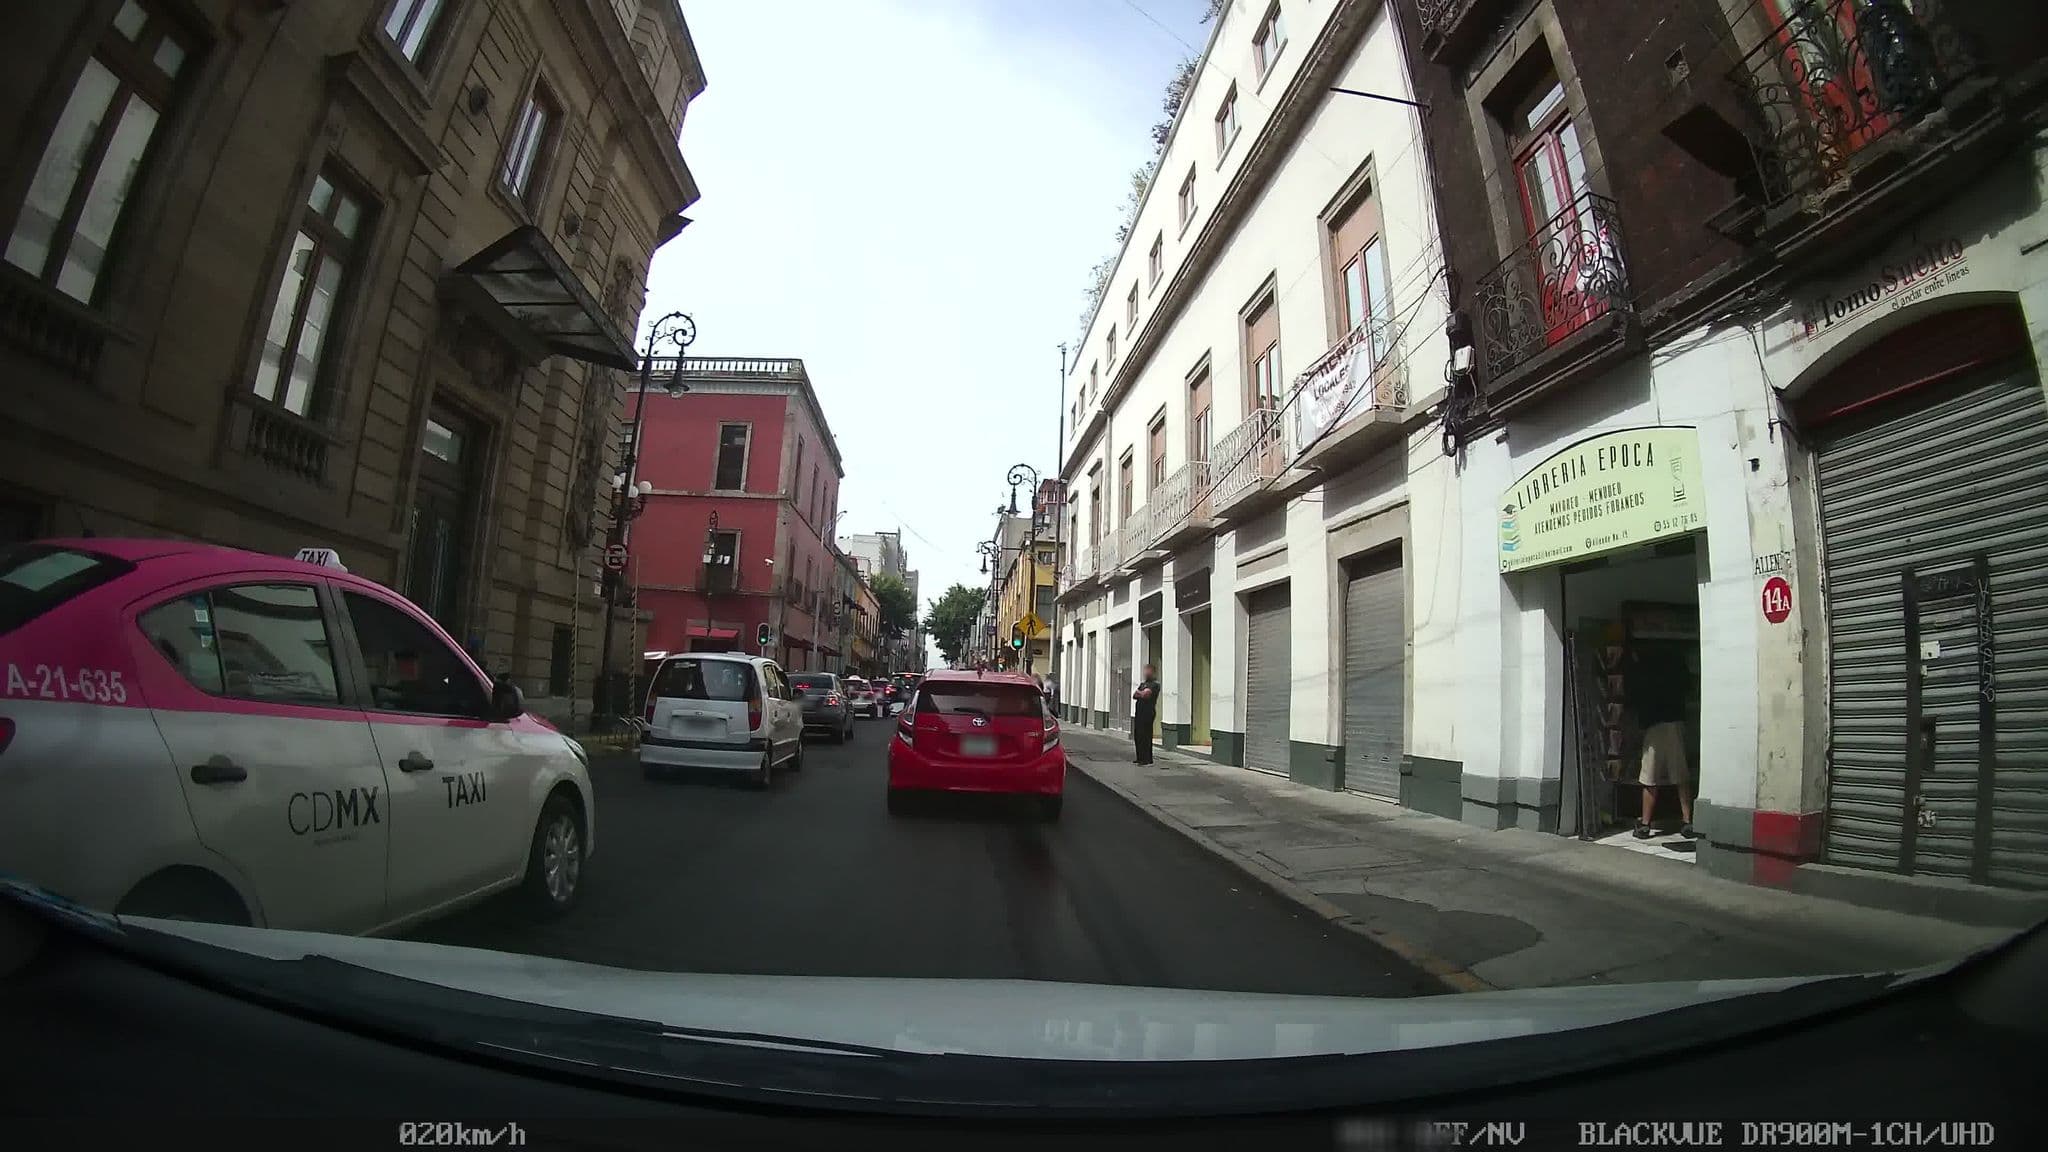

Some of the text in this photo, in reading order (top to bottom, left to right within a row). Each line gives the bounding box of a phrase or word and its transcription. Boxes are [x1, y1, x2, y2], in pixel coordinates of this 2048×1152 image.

[1891, 300, 1900, 311] el
[1901, 288, 1922, 306] andar
[1924, 278, 1945, 294] entre
[1517, 443, 1655, 510] LIBRERIA EPOCA
[1534, 492, 1645, 535] ATENDEMOS PEDIDOS FORANEOS
[1550, 495, 1579, 515] MAYOREO
[1589, 482, 1622, 504] MENUDEO
[302, 551, 329, 567] TAXI
[1754, 551, 1791, 575] ALLEN
[6, 663, 127, 704] A-21-635
[442, 771, 487, 809] TAXI
[288, 786, 380, 836] CDMX
